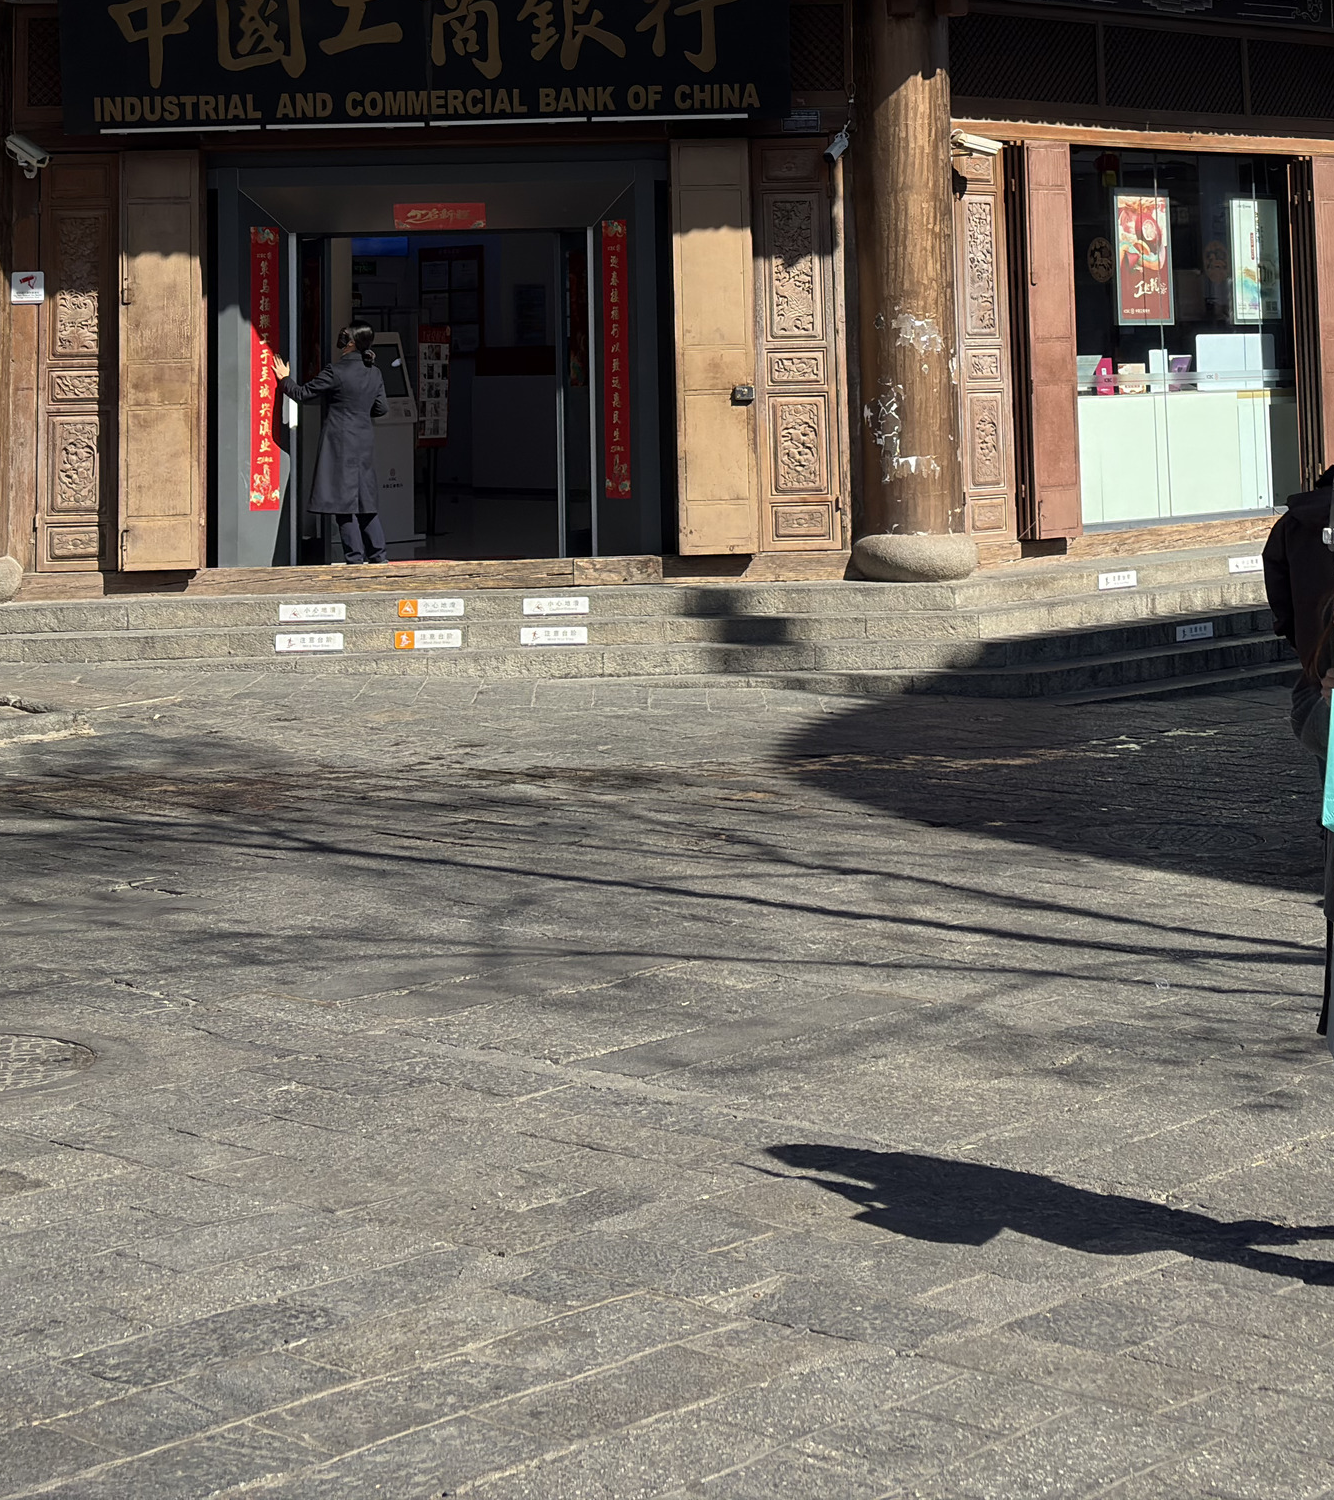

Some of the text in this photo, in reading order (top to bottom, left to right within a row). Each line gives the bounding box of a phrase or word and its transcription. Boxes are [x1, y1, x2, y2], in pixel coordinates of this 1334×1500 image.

[94, 82, 761, 123] INDUSTRIAL AND COMMERCIAL BANK OF CHINA
[423, 601, 456, 609] 小心地滑
[420, 633, 453, 641] 注意台阶
